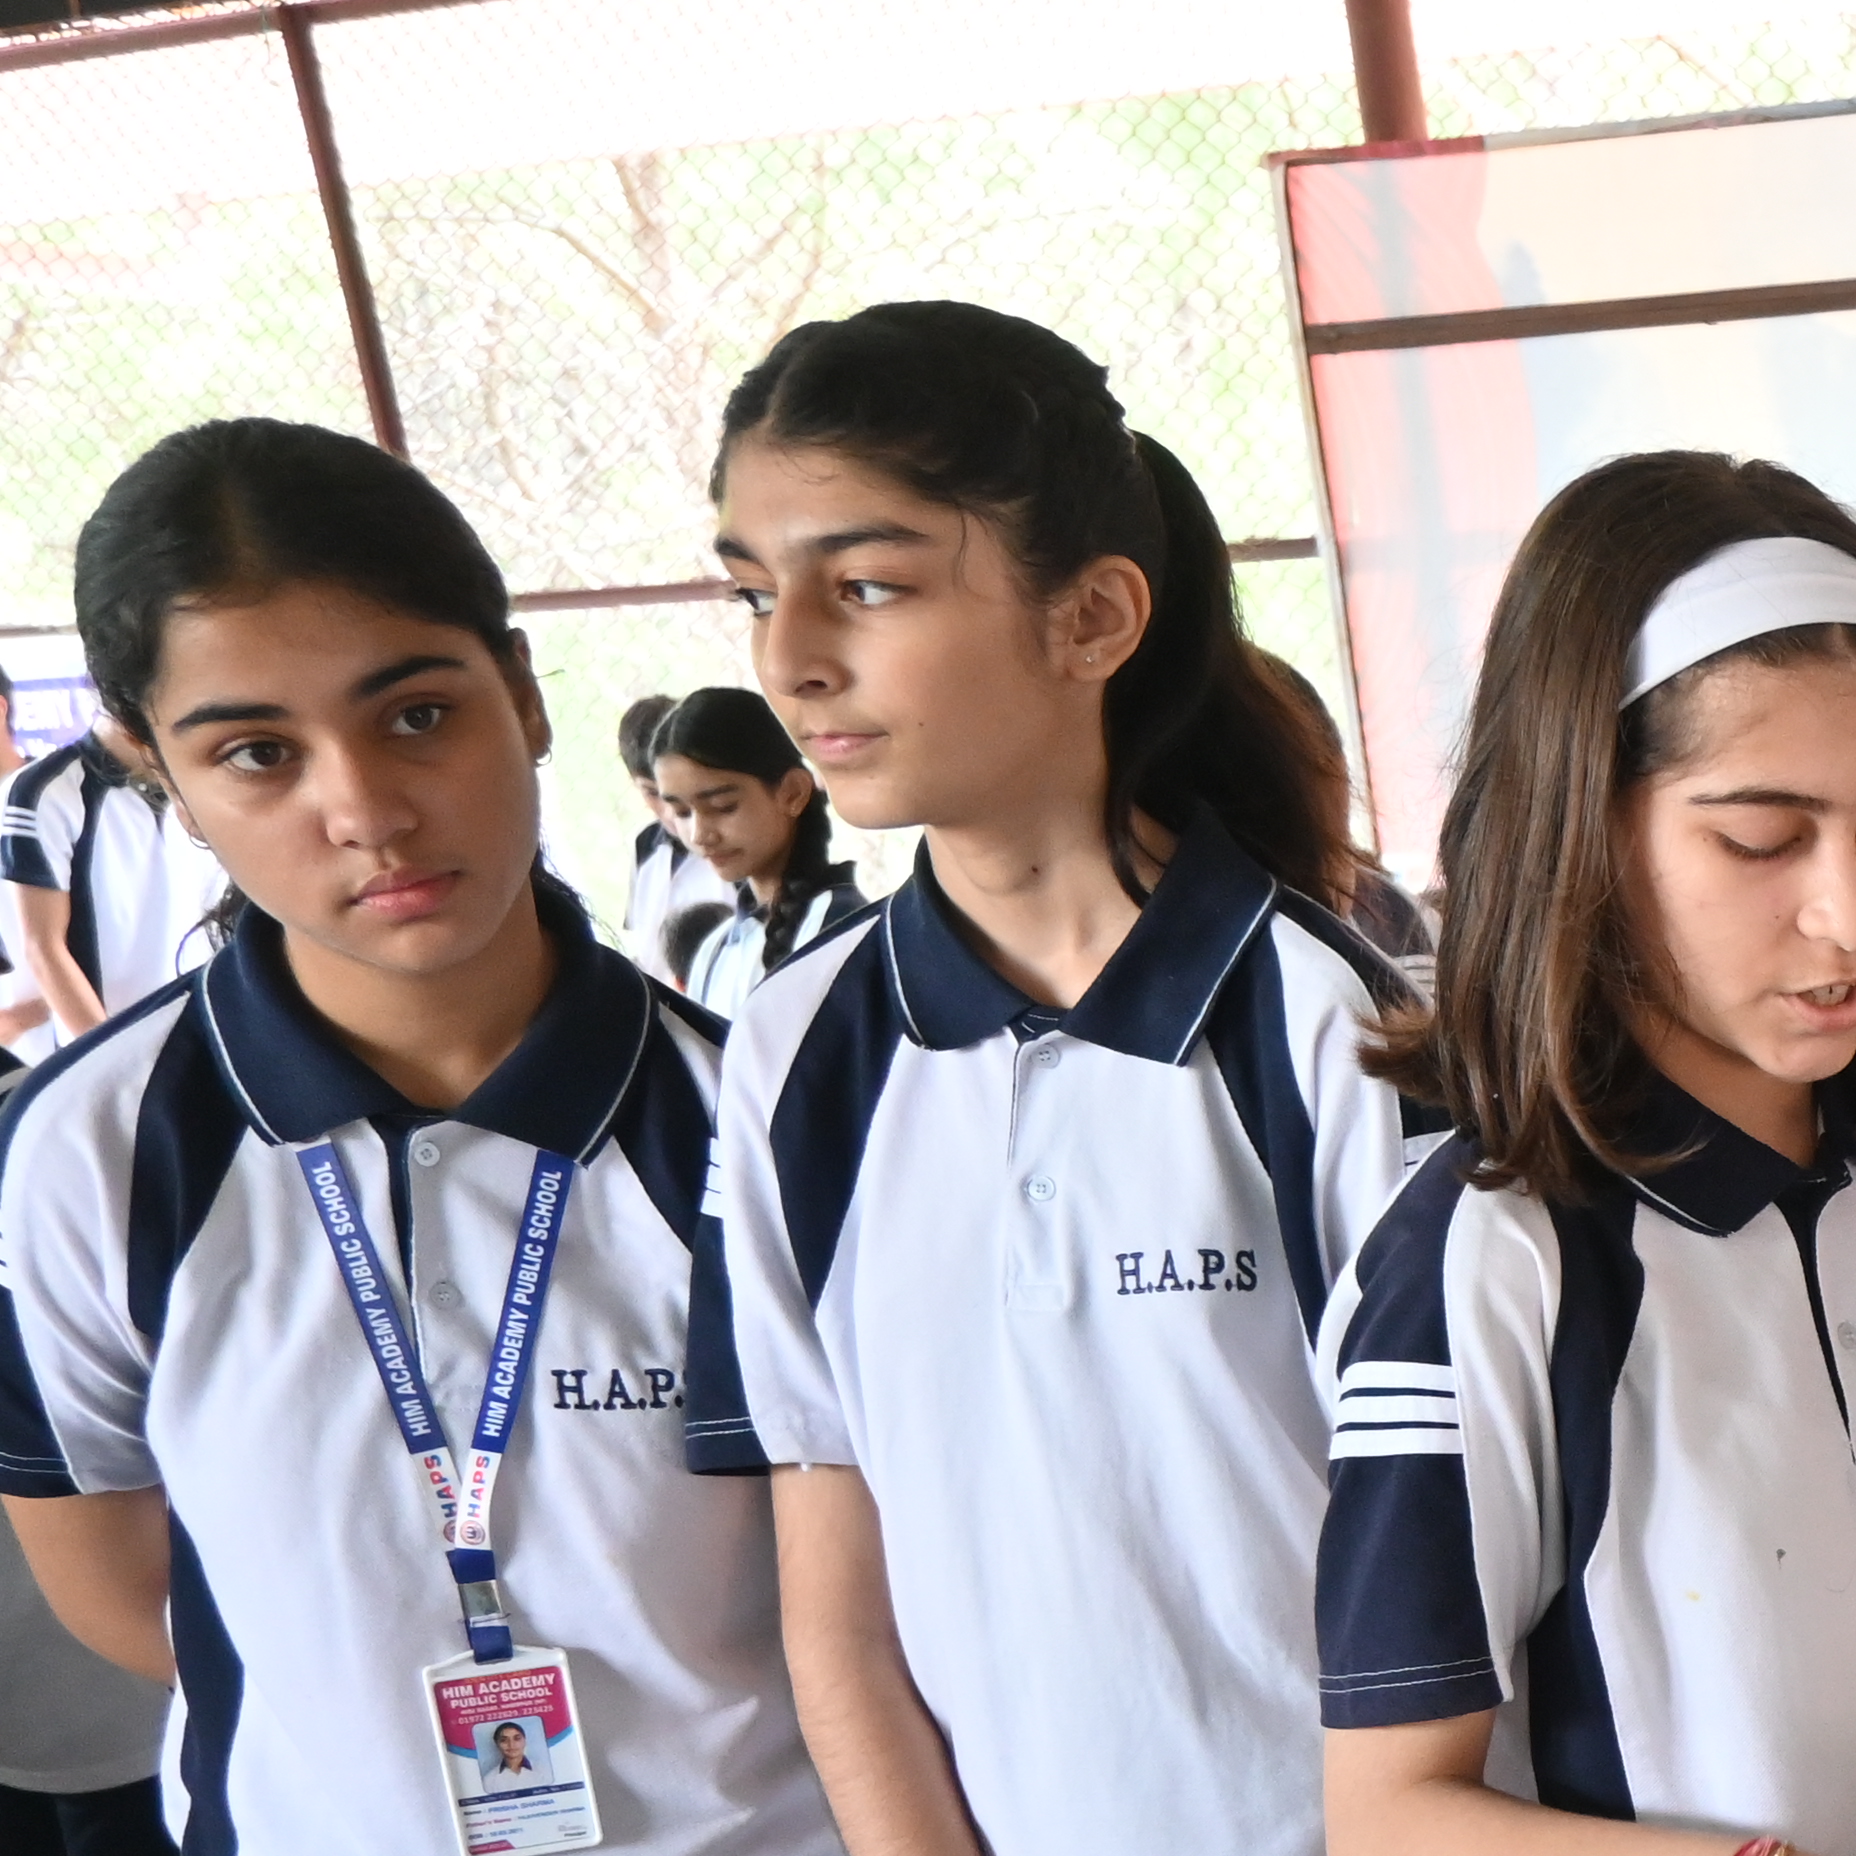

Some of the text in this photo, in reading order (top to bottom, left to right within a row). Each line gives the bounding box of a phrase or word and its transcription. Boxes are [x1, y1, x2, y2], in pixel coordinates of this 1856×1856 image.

[312, 1161, 432, 1438] HIM ACADEMY PUBLIC SCHOOL
[1115, 1247, 1258, 1297] H.A.P.S
[481, 1169, 563, 1438] HIM ACADEMY PUBLIC SCHOOL
[551, 1368, 685, 1411] H.A.P.
[423, 1452, 458, 1519] HAPS
[466, 1454, 491, 1519] HAPS
[442, 1684, 475, 1700] HIM
[478, 1672, 556, 1695] ACADEMY
[450, 1687, 554, 1709] PUBLIC SCHOOL
